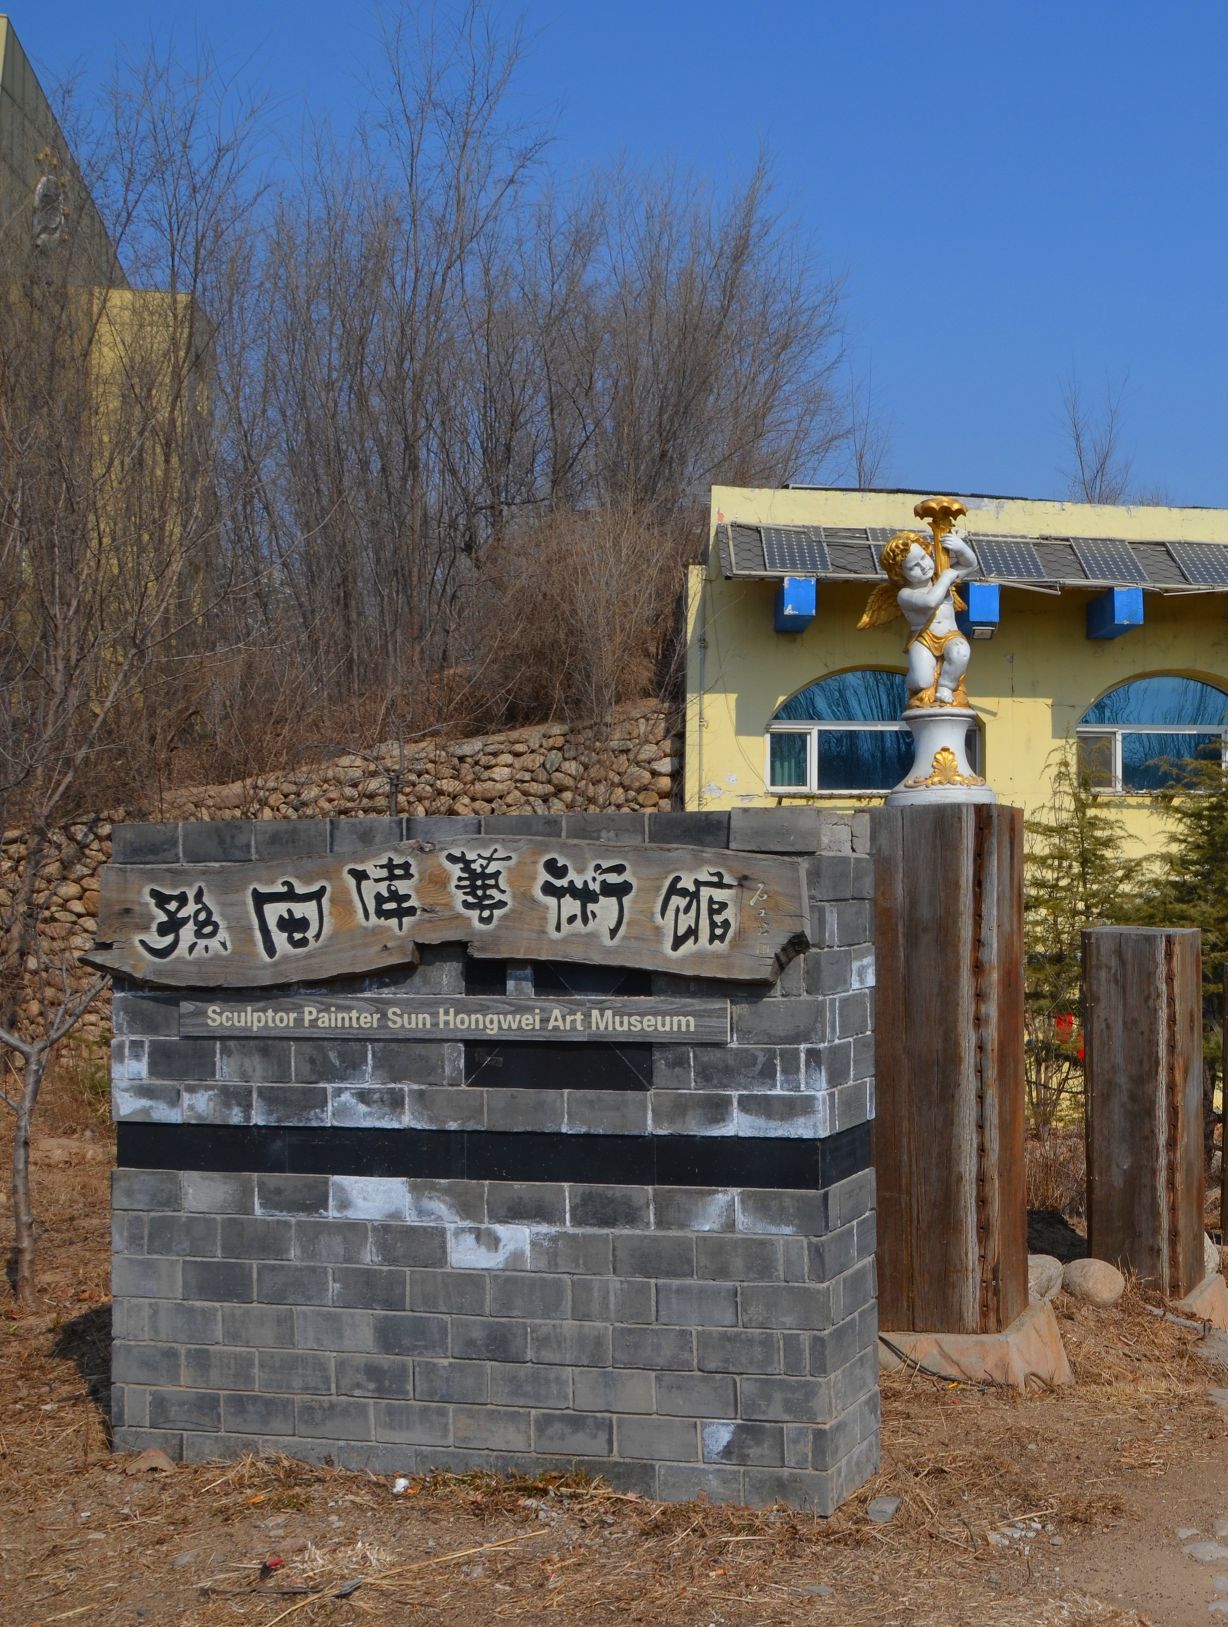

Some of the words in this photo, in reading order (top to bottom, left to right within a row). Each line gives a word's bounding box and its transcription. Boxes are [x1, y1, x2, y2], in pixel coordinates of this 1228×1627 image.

[206, 1005, 297, 1030] Sculptor
[304, 1006, 381, 1028] Painter
[388, 1008, 432, 1029] Sun
[439, 1008, 541, 1035] Hongwei
[548, 1009, 584, 1031] Art
[592, 1009, 696, 1033] Museum
